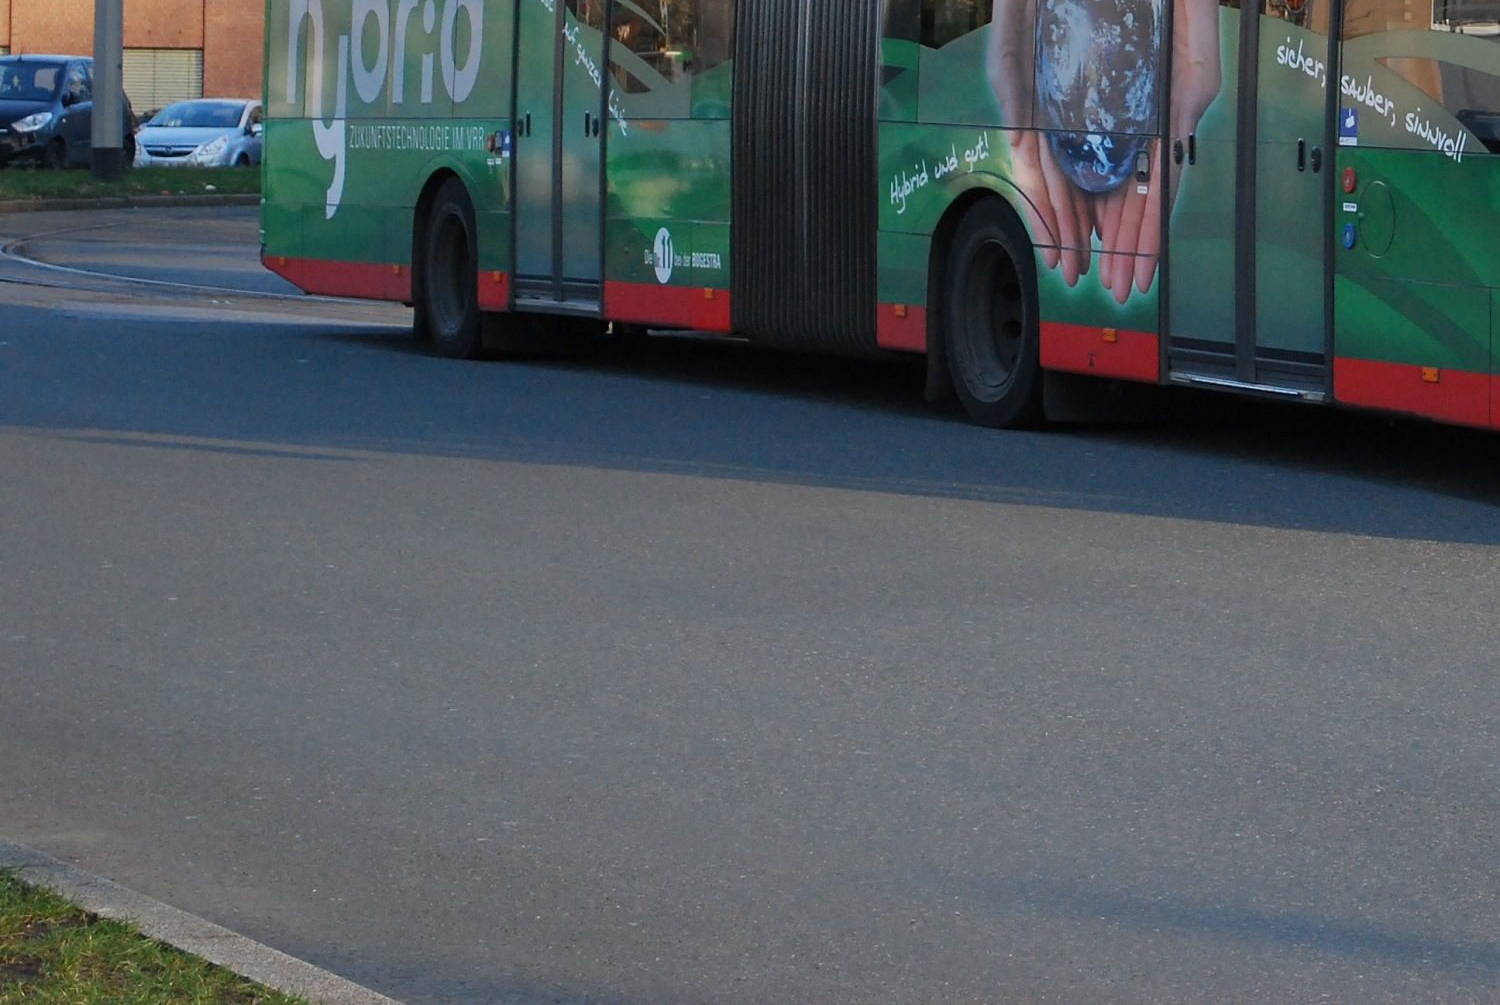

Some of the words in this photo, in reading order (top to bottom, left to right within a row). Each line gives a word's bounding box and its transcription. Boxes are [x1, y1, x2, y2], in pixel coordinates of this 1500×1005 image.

[1276, 36, 1327, 88] sicher,
[350, 125, 449, 150] ZUKUNFTSTECHNOLOGIE
[452, 126, 464, 150] IM
[466, 126, 485, 151] VRR
[889, 158, 929, 214] Hybrid
